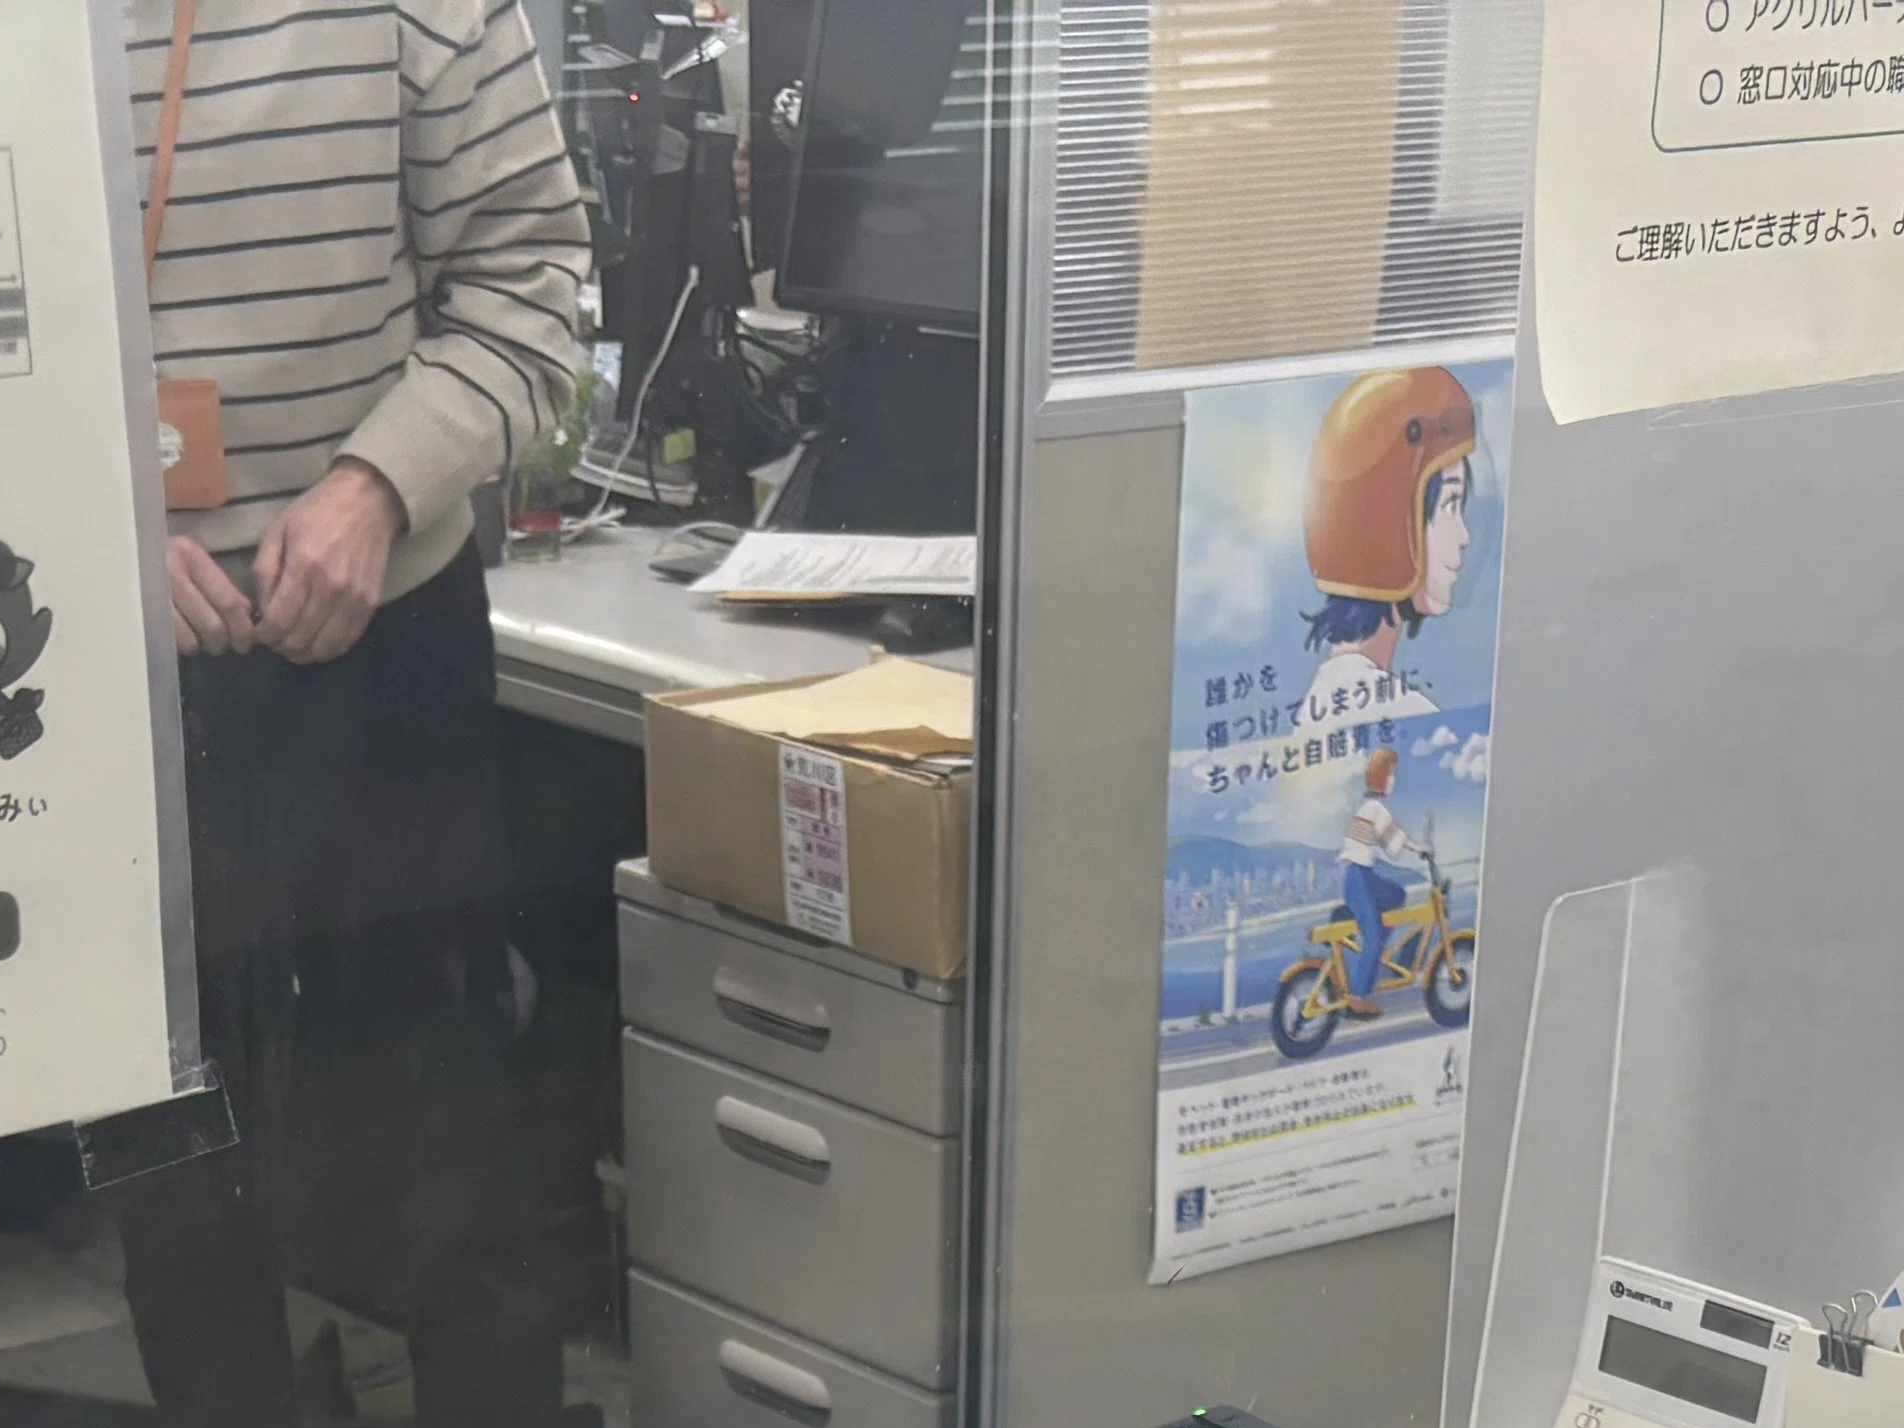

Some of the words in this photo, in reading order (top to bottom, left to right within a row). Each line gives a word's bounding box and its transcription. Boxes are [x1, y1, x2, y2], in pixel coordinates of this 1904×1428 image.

[1205, 664, 1279, 708] 誰かを
[1205, 668, 1434, 752] 傷つけてしまう前に、
[1207, 718, 1409, 796] ちゃんと自賠責を。
